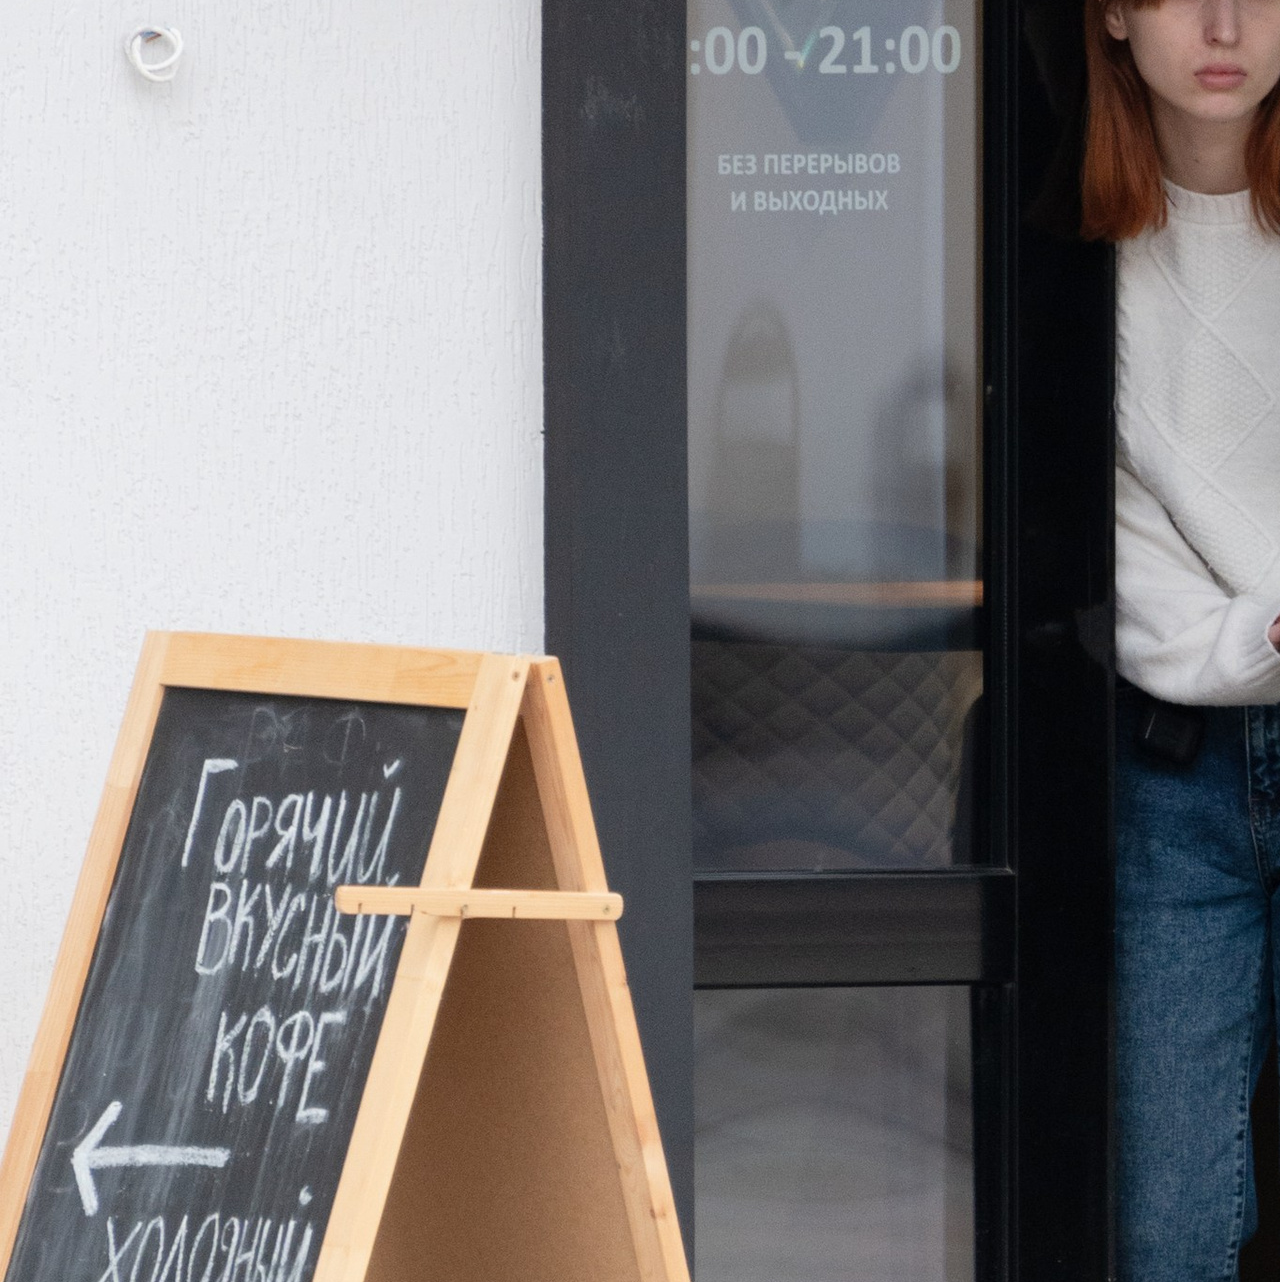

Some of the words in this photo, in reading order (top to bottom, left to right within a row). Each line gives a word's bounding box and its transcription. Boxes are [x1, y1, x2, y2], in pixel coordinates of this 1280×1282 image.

[818, 25, 961, 75] 21:00
[717, 154, 756, 175] БЕЗ
[764, 153, 900, 175] ПЕРЕРЫВОВ
[731, 192, 746, 211] И
[753, 190, 888, 215] ВЫХОДНЫХ
[206, 1007, 346, 1124] КОФЕ
